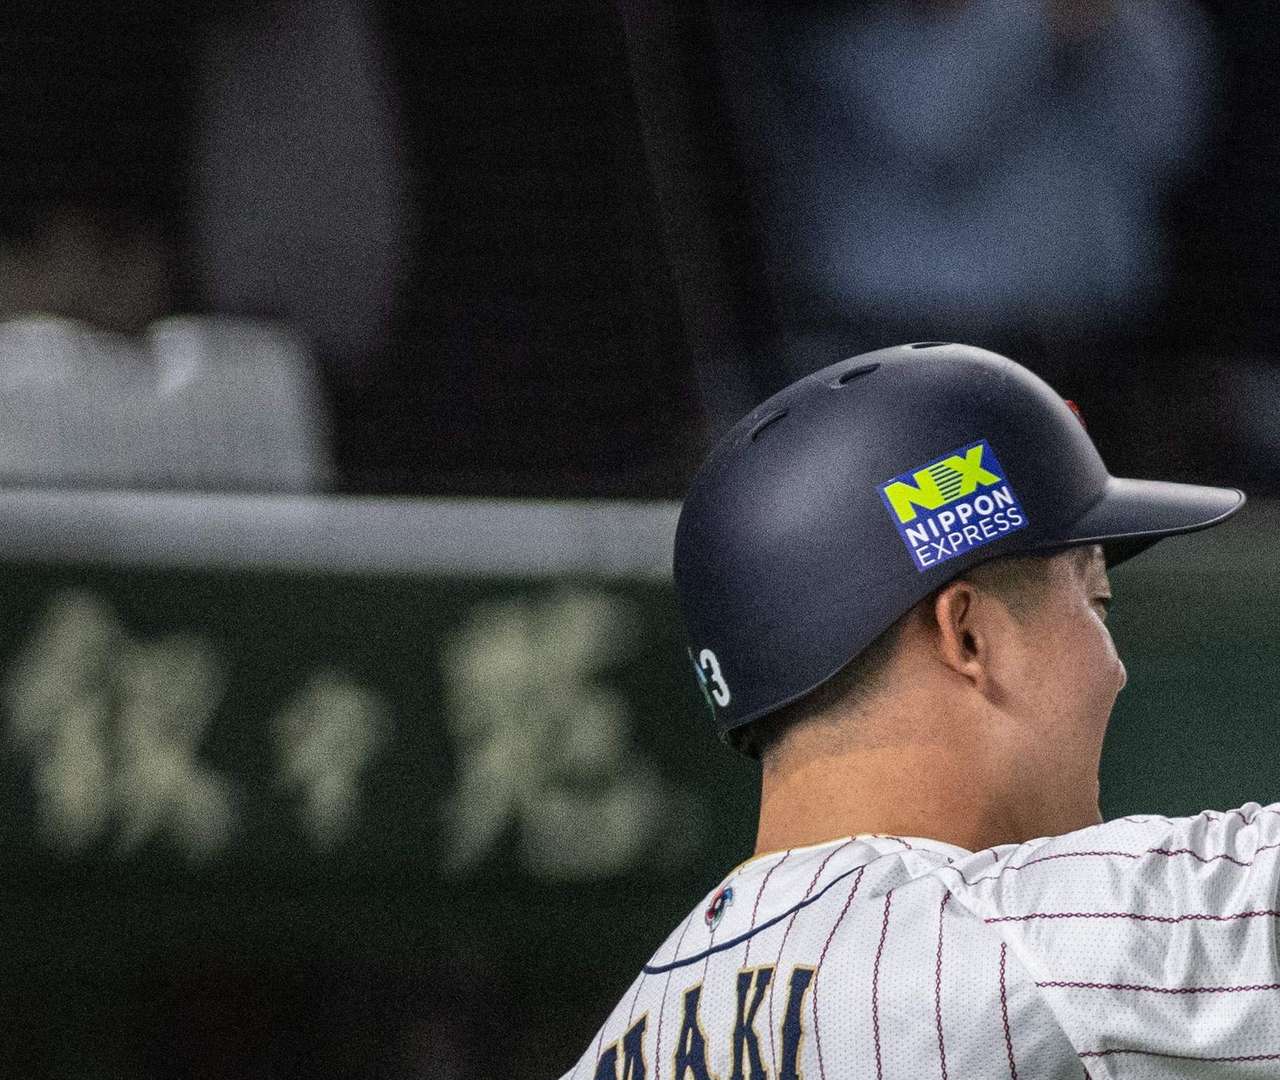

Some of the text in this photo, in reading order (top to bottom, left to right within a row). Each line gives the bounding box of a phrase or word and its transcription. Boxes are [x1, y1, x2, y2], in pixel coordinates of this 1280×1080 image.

[905, 486, 1014, 547] NIPPON
[915, 507, 1023, 566] EXPRESS
[700, 648, 730, 707] 3
